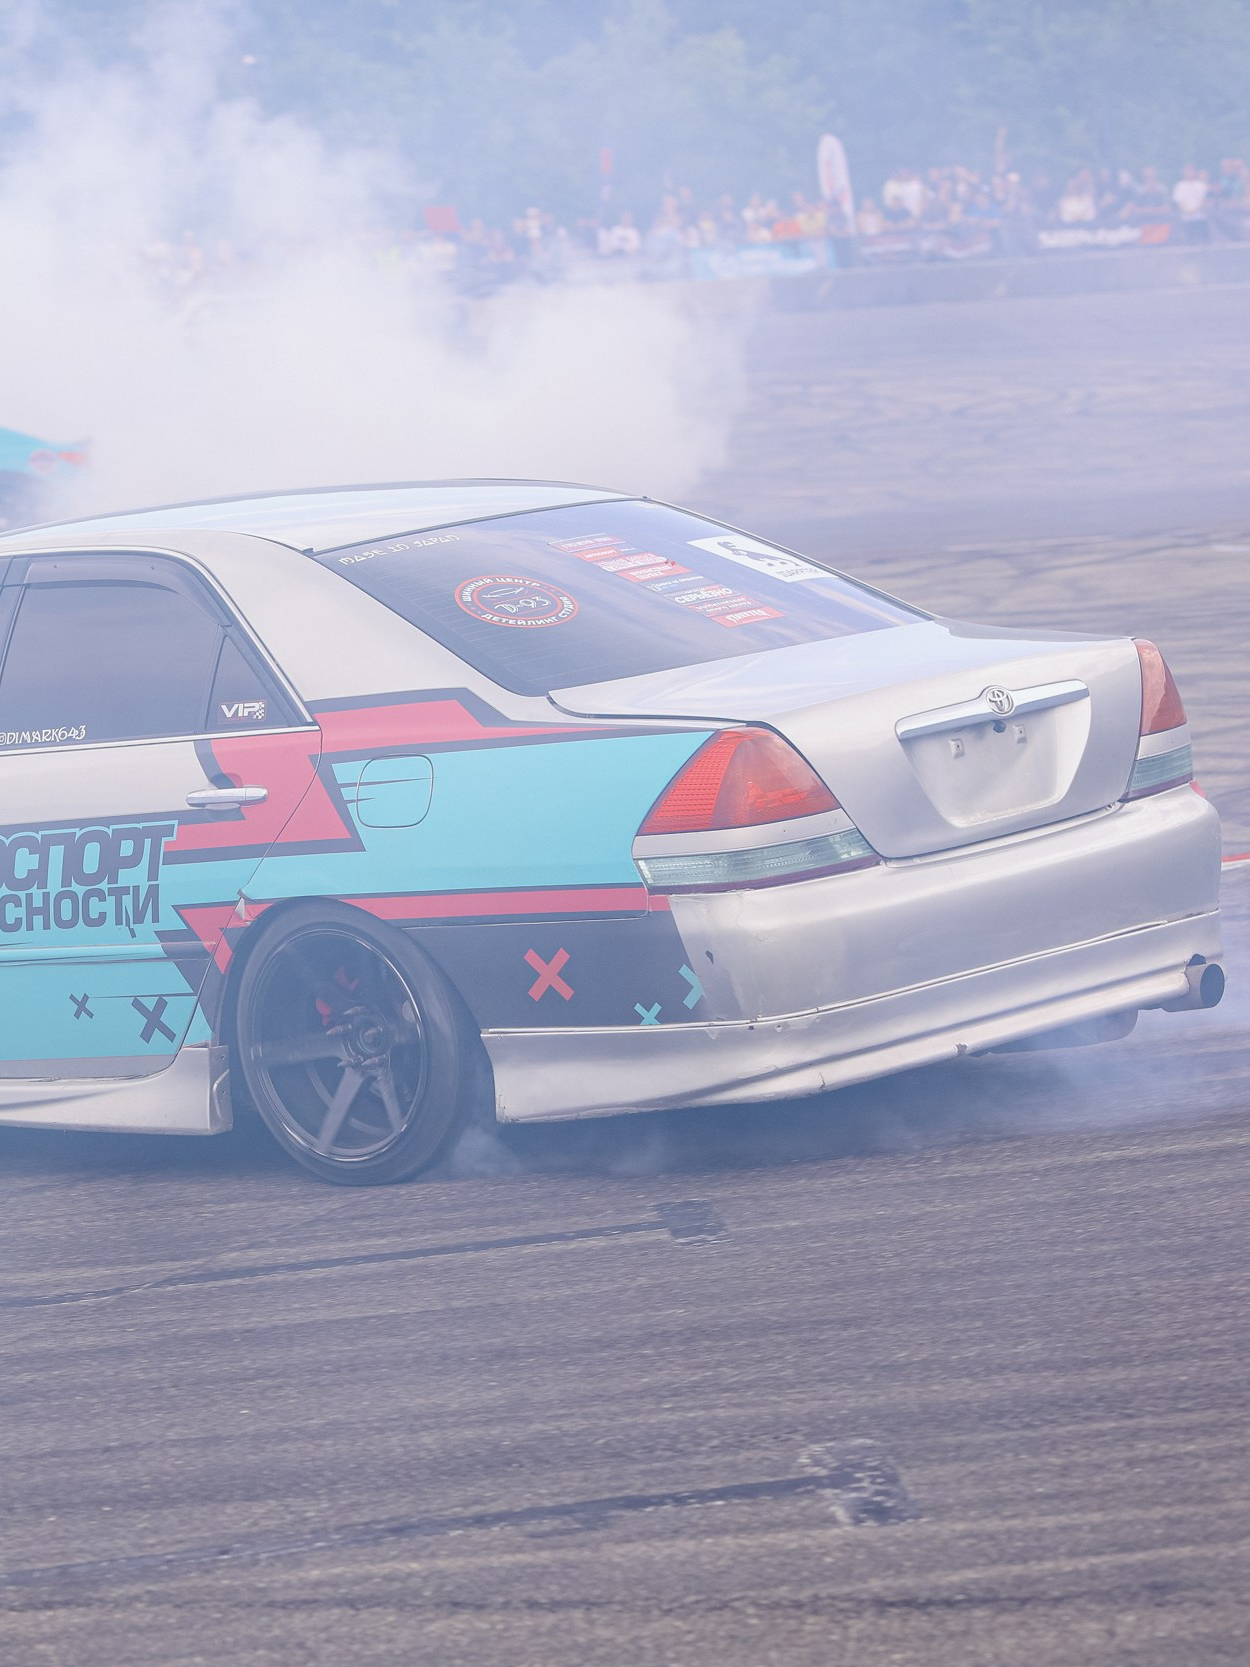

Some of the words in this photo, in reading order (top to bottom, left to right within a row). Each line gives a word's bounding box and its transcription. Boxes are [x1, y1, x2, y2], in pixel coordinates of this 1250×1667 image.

[338, 548, 387, 566] MADE
[388, 543, 410, 553] IN
[413, 534, 460, 548] JAPAN
[461, 577, 494, 602] ШИННЫЙ
[495, 577, 541, 588] ЦЕНТР
[674, 587, 733, 605] СЕРЬЁЗНО
[481, 613, 558, 626] ДЕТЕЙЛИНГ
[558, 595, 575, 618] СТУДИЯ
[220, 702, 260, 718] VIP
